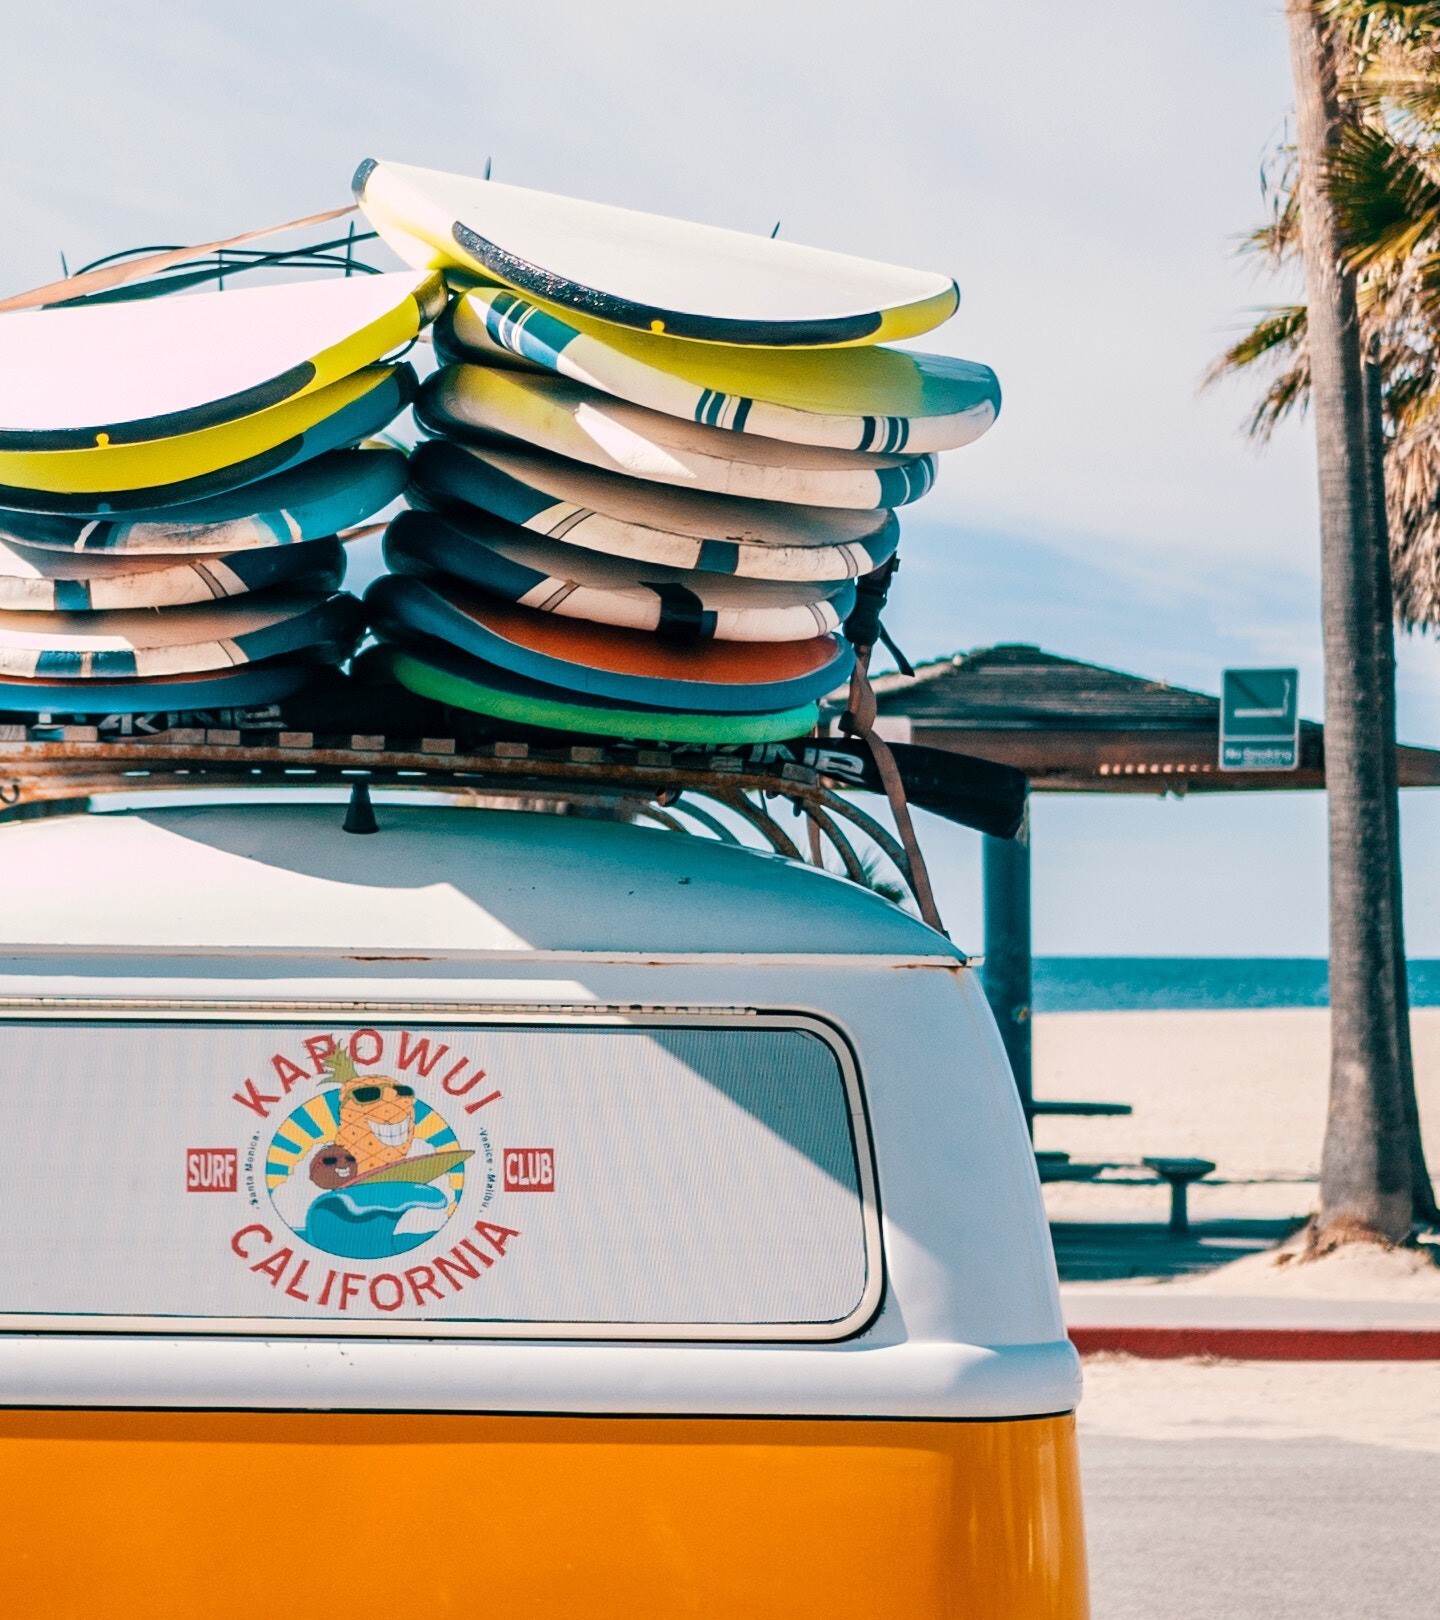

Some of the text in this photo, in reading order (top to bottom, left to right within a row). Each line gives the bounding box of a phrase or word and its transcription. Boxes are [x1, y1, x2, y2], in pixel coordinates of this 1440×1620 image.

[232, 1028, 503, 1118] KAPOWUI
[187, 1153, 236, 1189] SURF
[244, 1135, 260, 1206] Santa Monica
[506, 1153, 553, 1187] CLUB
[231, 1219, 522, 1312] CALIFORNIA
